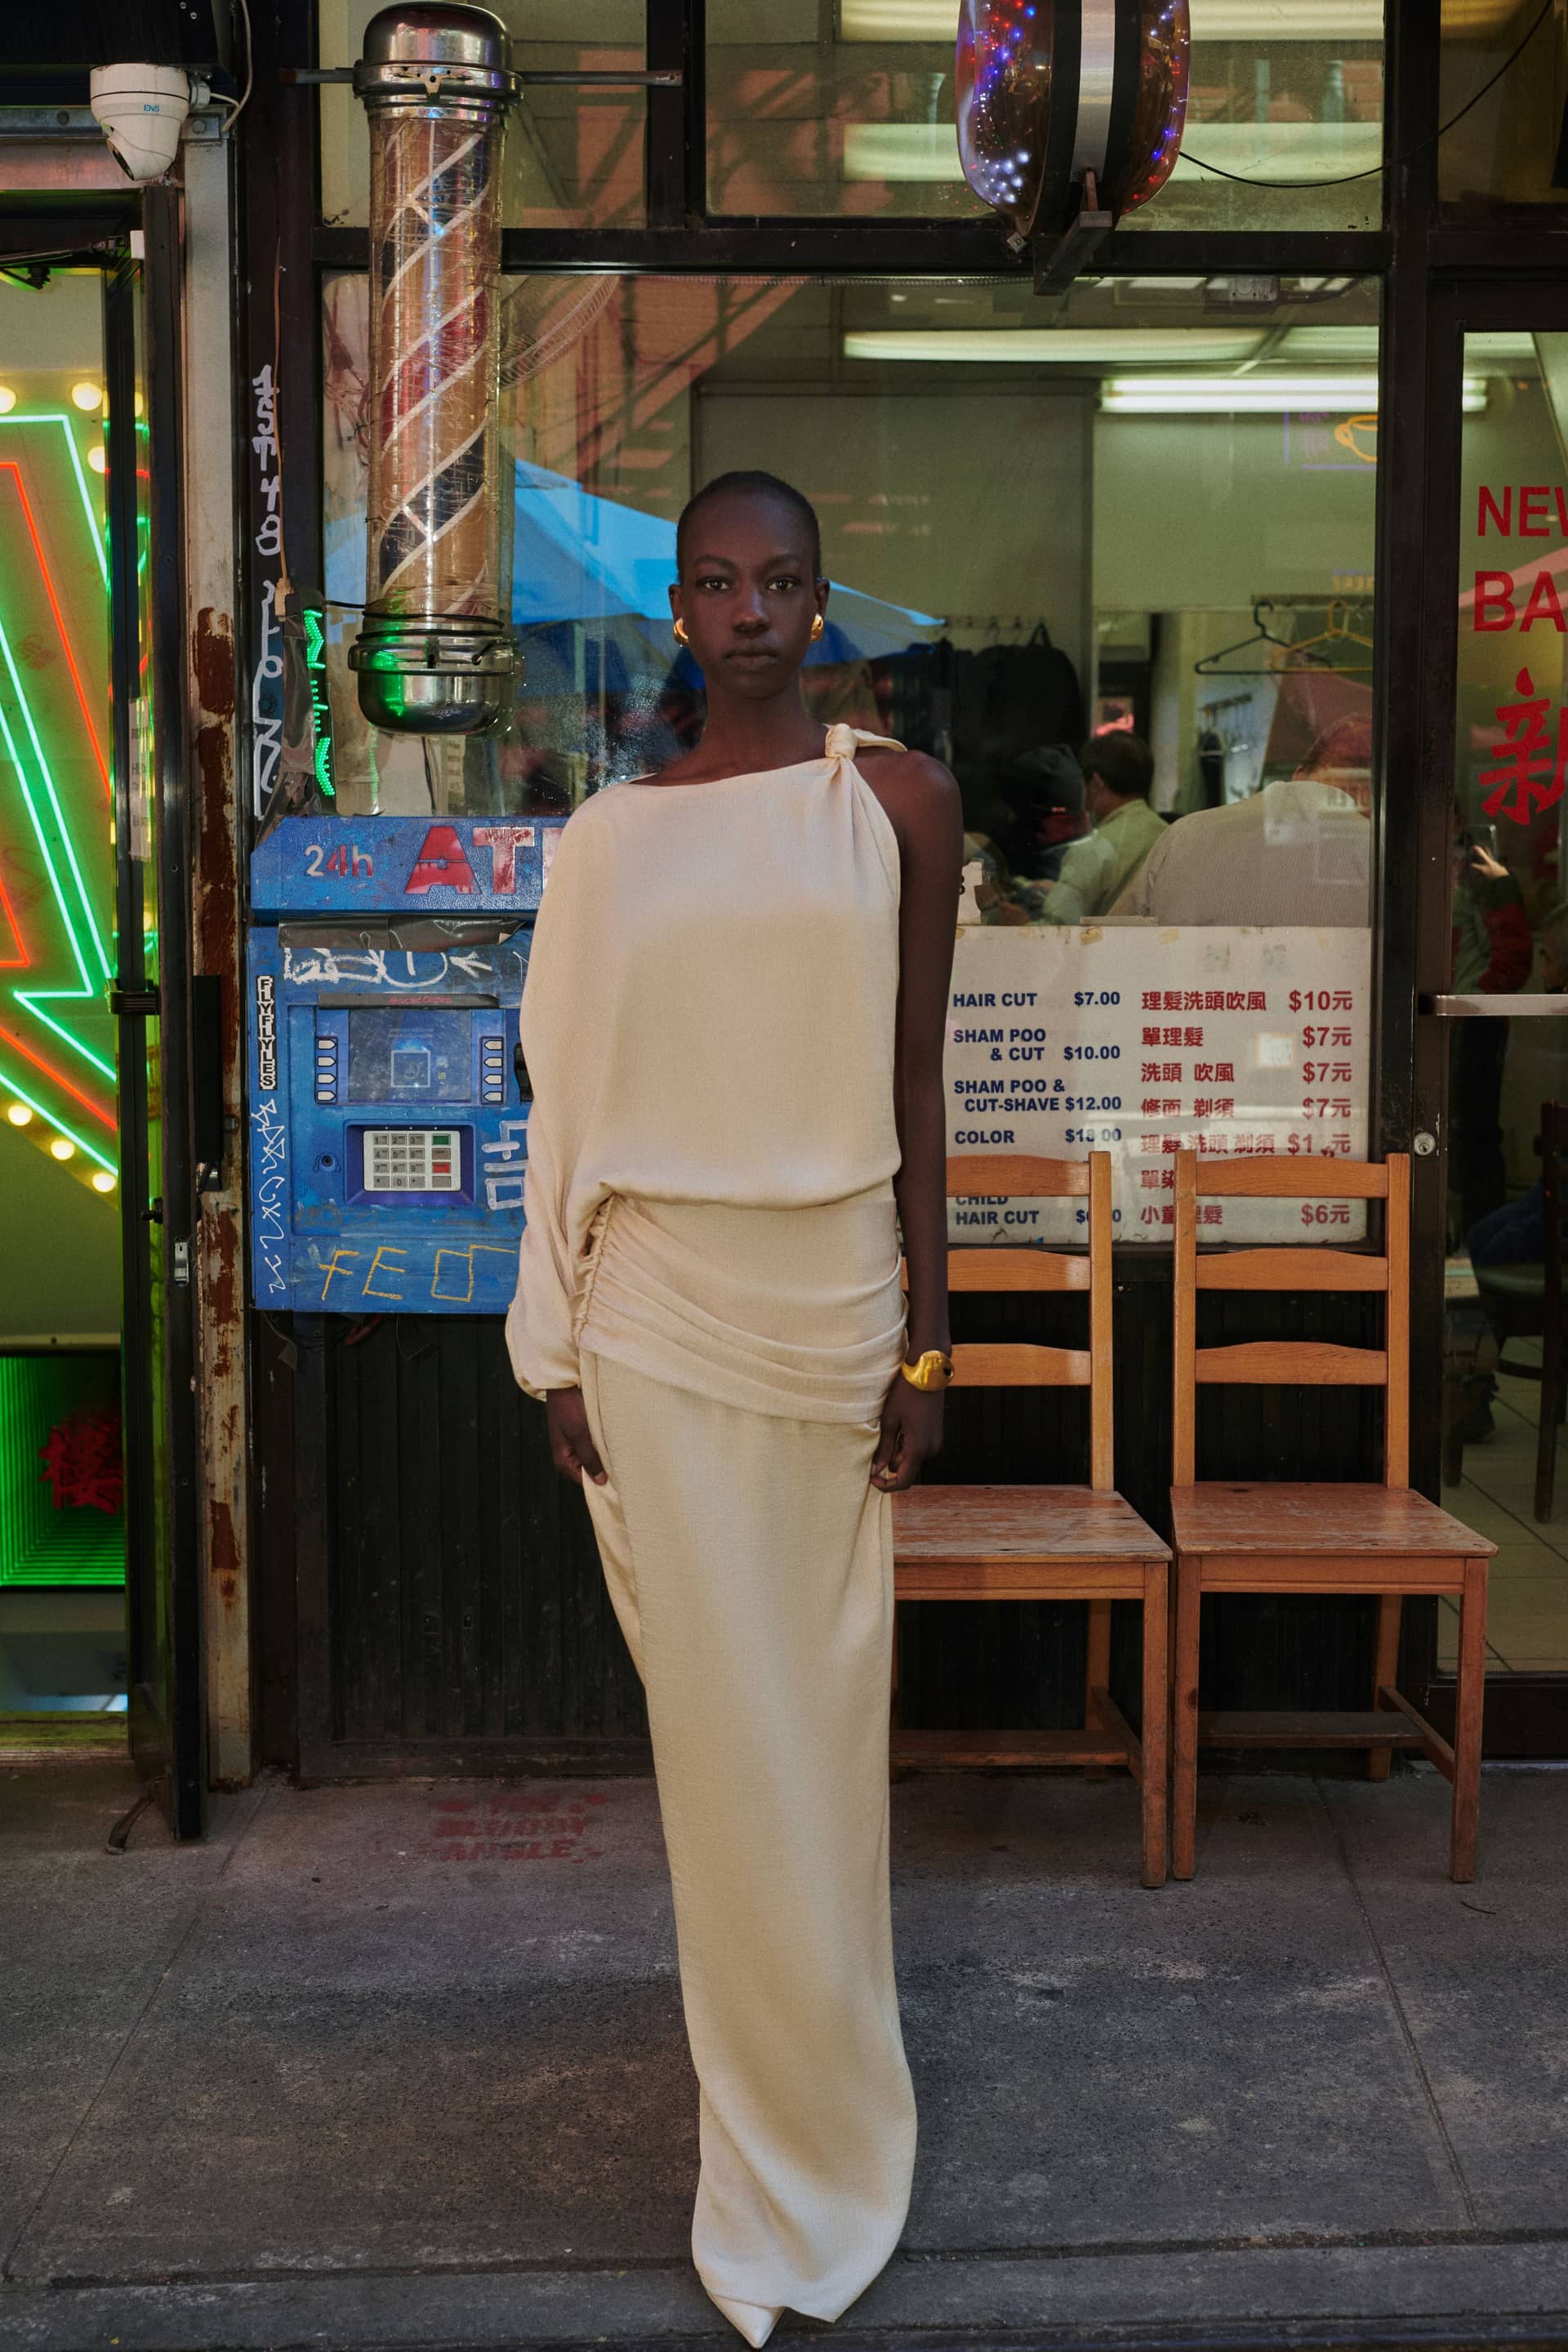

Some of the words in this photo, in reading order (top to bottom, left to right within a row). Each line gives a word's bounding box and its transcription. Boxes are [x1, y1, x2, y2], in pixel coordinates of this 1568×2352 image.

[1477, 485, 1568, 537] NE
[304, 844, 373, 878] 24h
[404, 825, 567, 896] AT
[953, 993, 996, 1007] HAIR
[1001, 993, 1037, 1007] CUT
[1074, 991, 1120, 1007] $7.00
[1142, 991, 1267, 1012] 理髮洗頭吹風
[1289, 990, 1353, 1013] $10元
[953, 1029, 1004, 1043] SHAM
[1009, 1028, 1046, 1042] POO
[1142, 1027, 1204, 1047] 單理髮
[1303, 1026, 1352, 1049] $7元
[990, 1047, 1003, 1061] &
[1009, 1047, 1045, 1061] CUT
[1063, 1045, 1120, 1062] $10.00
[1141, 1062, 1183, 1083] 洗頭
[1194, 1062, 1235, 1083] 吹風
[1303, 1062, 1352, 1084] $7元
[954, 1080, 1004, 1094] SHAM
[1010, 1079, 1047, 1093] POO
[1053, 1079, 1066, 1093] &
[964, 1098, 1060, 1111] CUT-SHAVE
[1065, 1096, 1121, 1111] $12.00
[955, 1130, 1015, 1144] COLOR
[956, 1212, 999, 1225] HAIR
[1004, 1210, 1040, 1224] CUT
[1301, 1203, 1351, 1227] $6元
